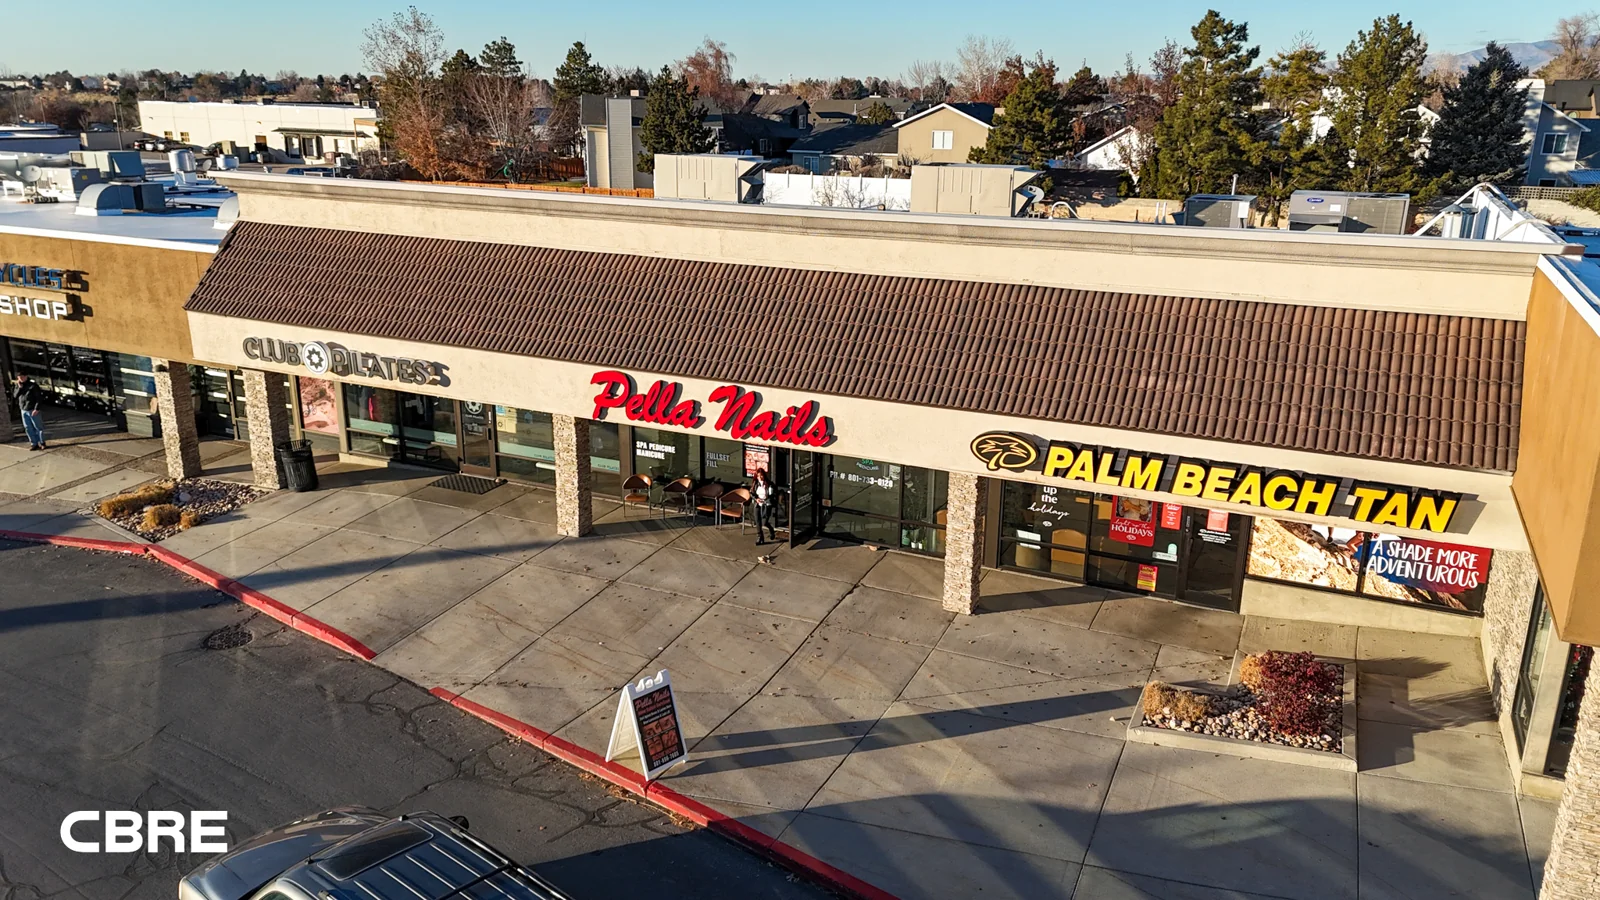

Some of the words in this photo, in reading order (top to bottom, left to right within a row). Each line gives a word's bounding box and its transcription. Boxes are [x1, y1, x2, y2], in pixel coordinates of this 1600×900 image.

[0, 295, 68, 320] SHOP
[243, 336, 300, 366] CLUB
[331, 350, 430, 386] PILATES
[590, 370, 700, 428] Pella
[708, 385, 831, 448] Nails
[636, 441, 648, 449] SPA
[648, 442, 676, 454] PEDICURE
[636, 448, 665, 460] MANICURE
[706, 452, 730, 462] FULLSET
[706, 460, 718, 468] FILL
[1042, 445, 1164, 493] PALM
[1171, 461, 1338, 517] BEACH
[1352, 487, 1458, 534] TAN
[1043, 486, 1058, 495] up
[1041, 494, 1058, 504] the
[1027, 501, 1070, 520] holidays
[1111, 523, 1154, 537] HOLIDAYS
[1371, 539, 1383, 556] A
[1386, 541, 1434, 563] SHADE
[1436, 548, 1479, 570] MORE
[1365, 555, 1480, 589] ADVENTUROUS
